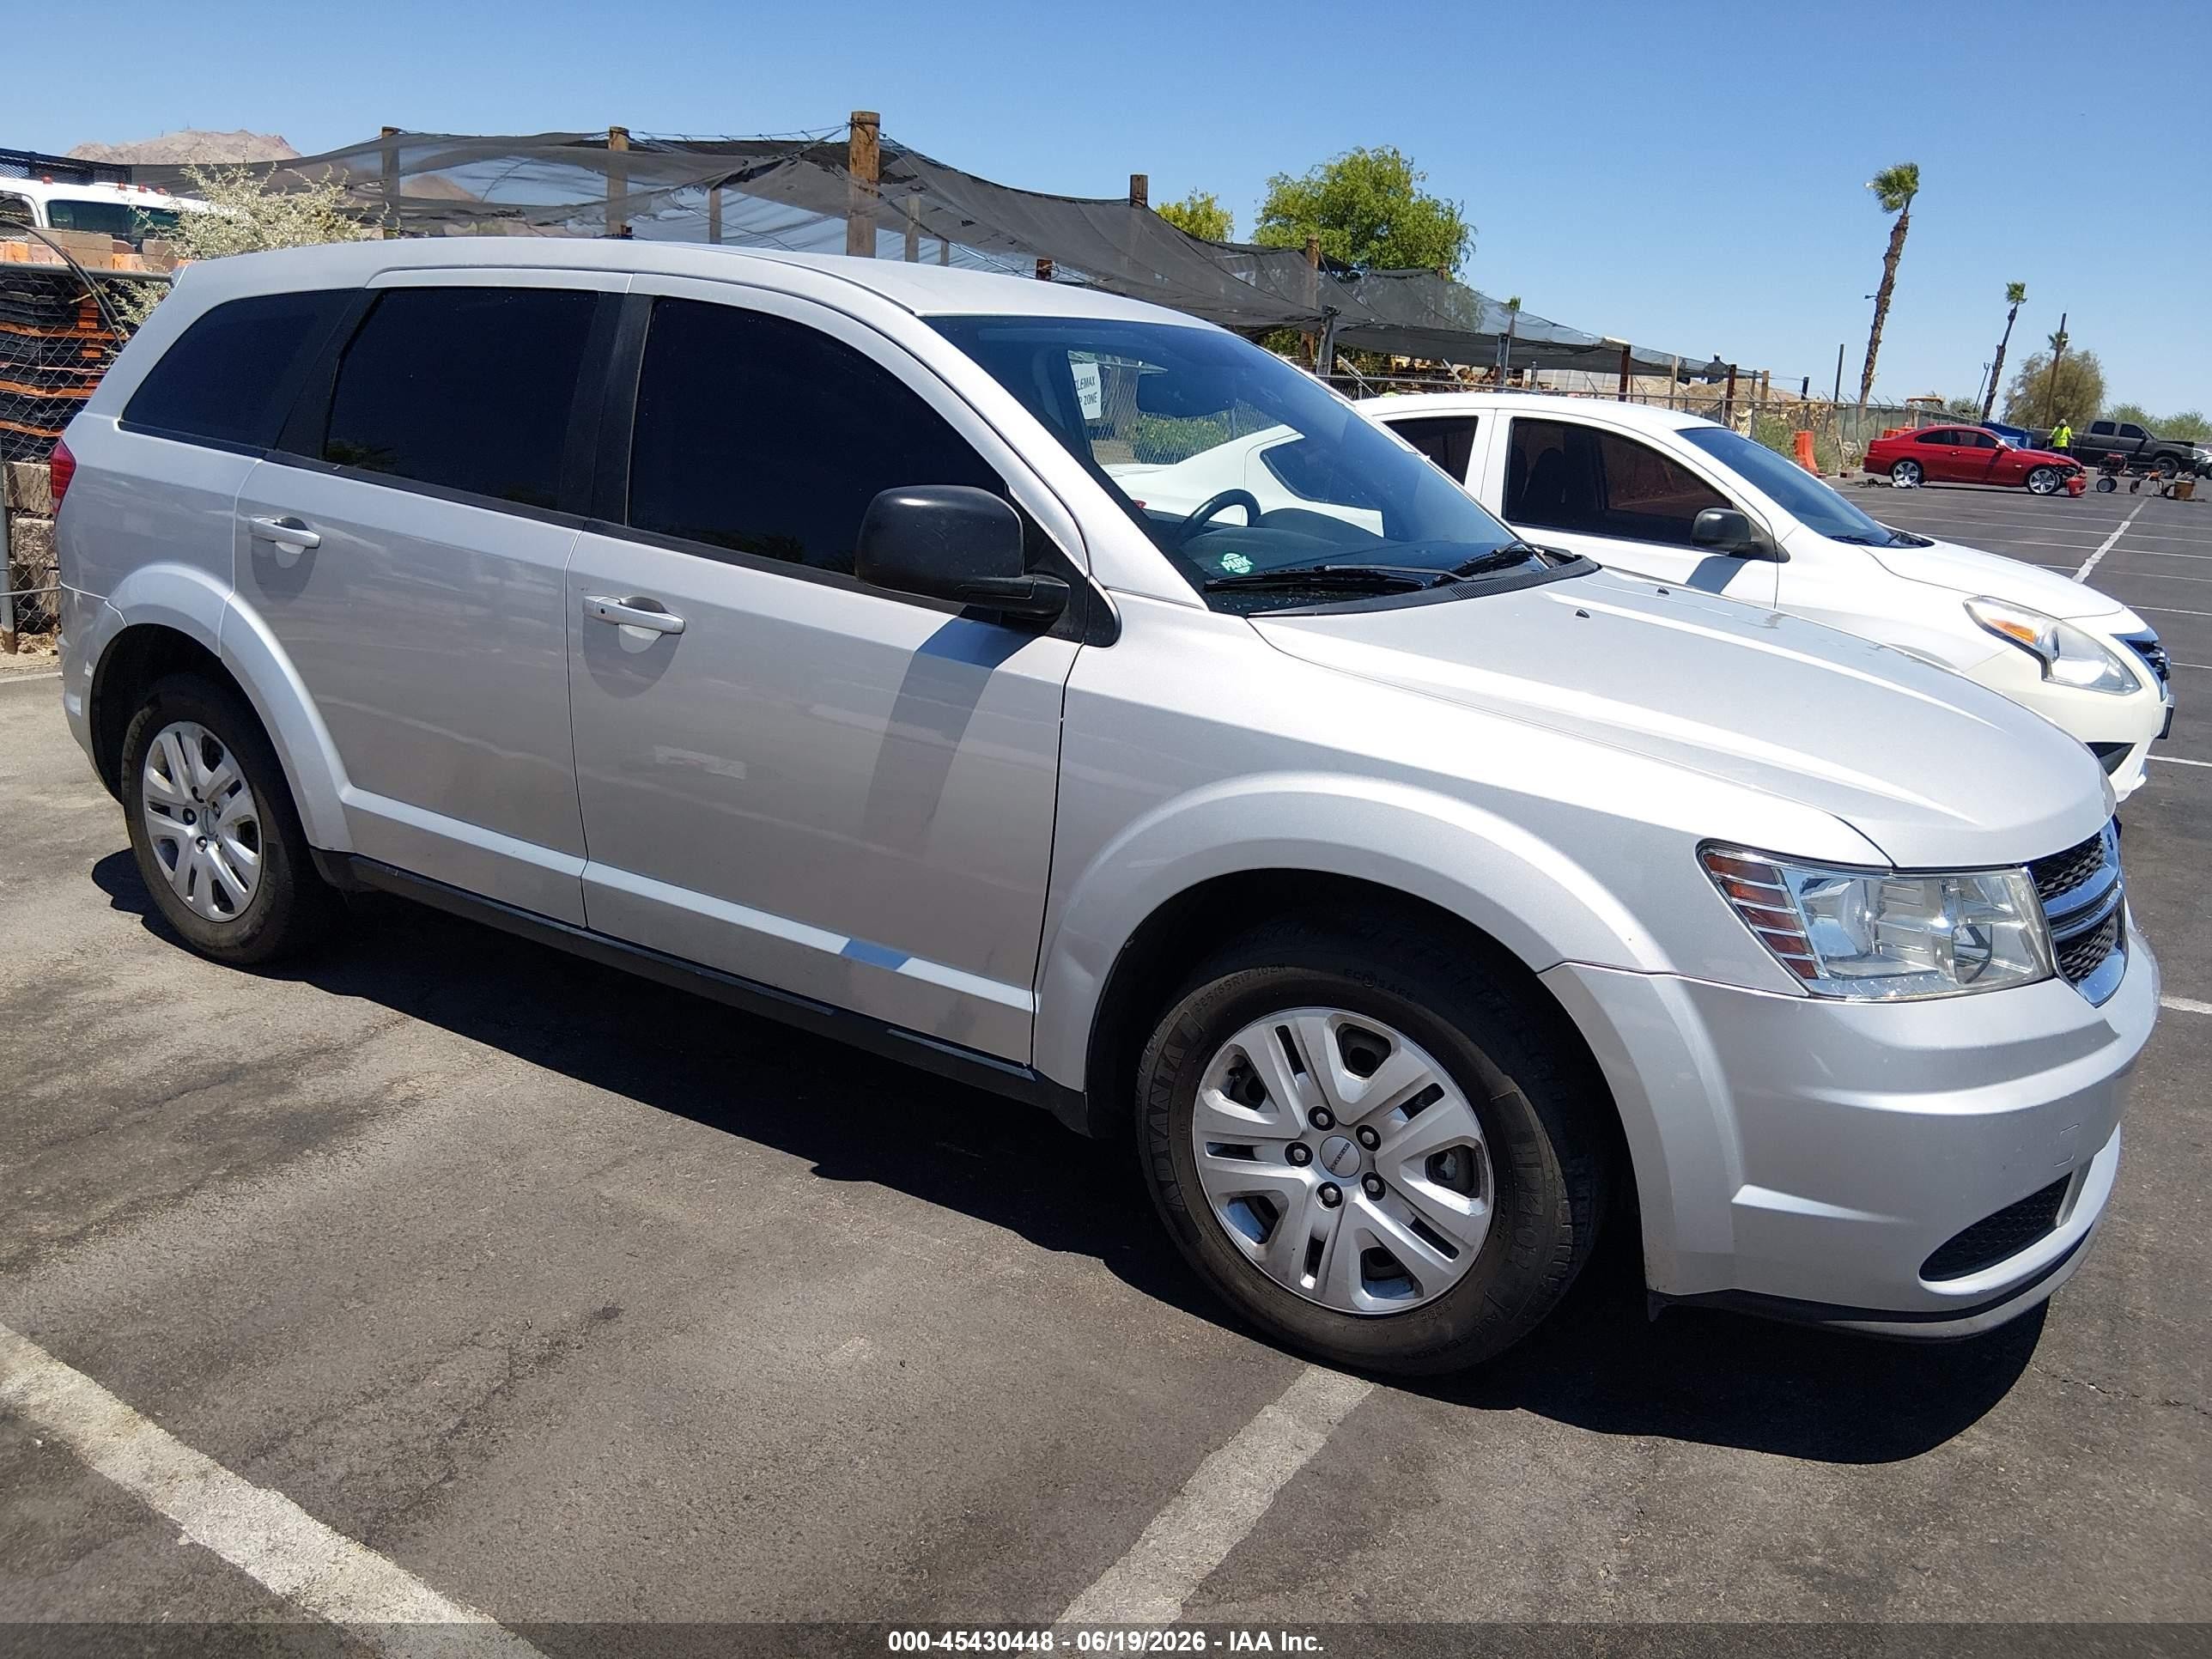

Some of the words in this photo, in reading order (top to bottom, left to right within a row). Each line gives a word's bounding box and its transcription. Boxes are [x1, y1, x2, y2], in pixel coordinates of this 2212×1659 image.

[1084, 392, 1097, 406] ZONE
[1220, 556, 1254, 571] PARK
[1148, 1042, 1187, 1211] ADVANTA
